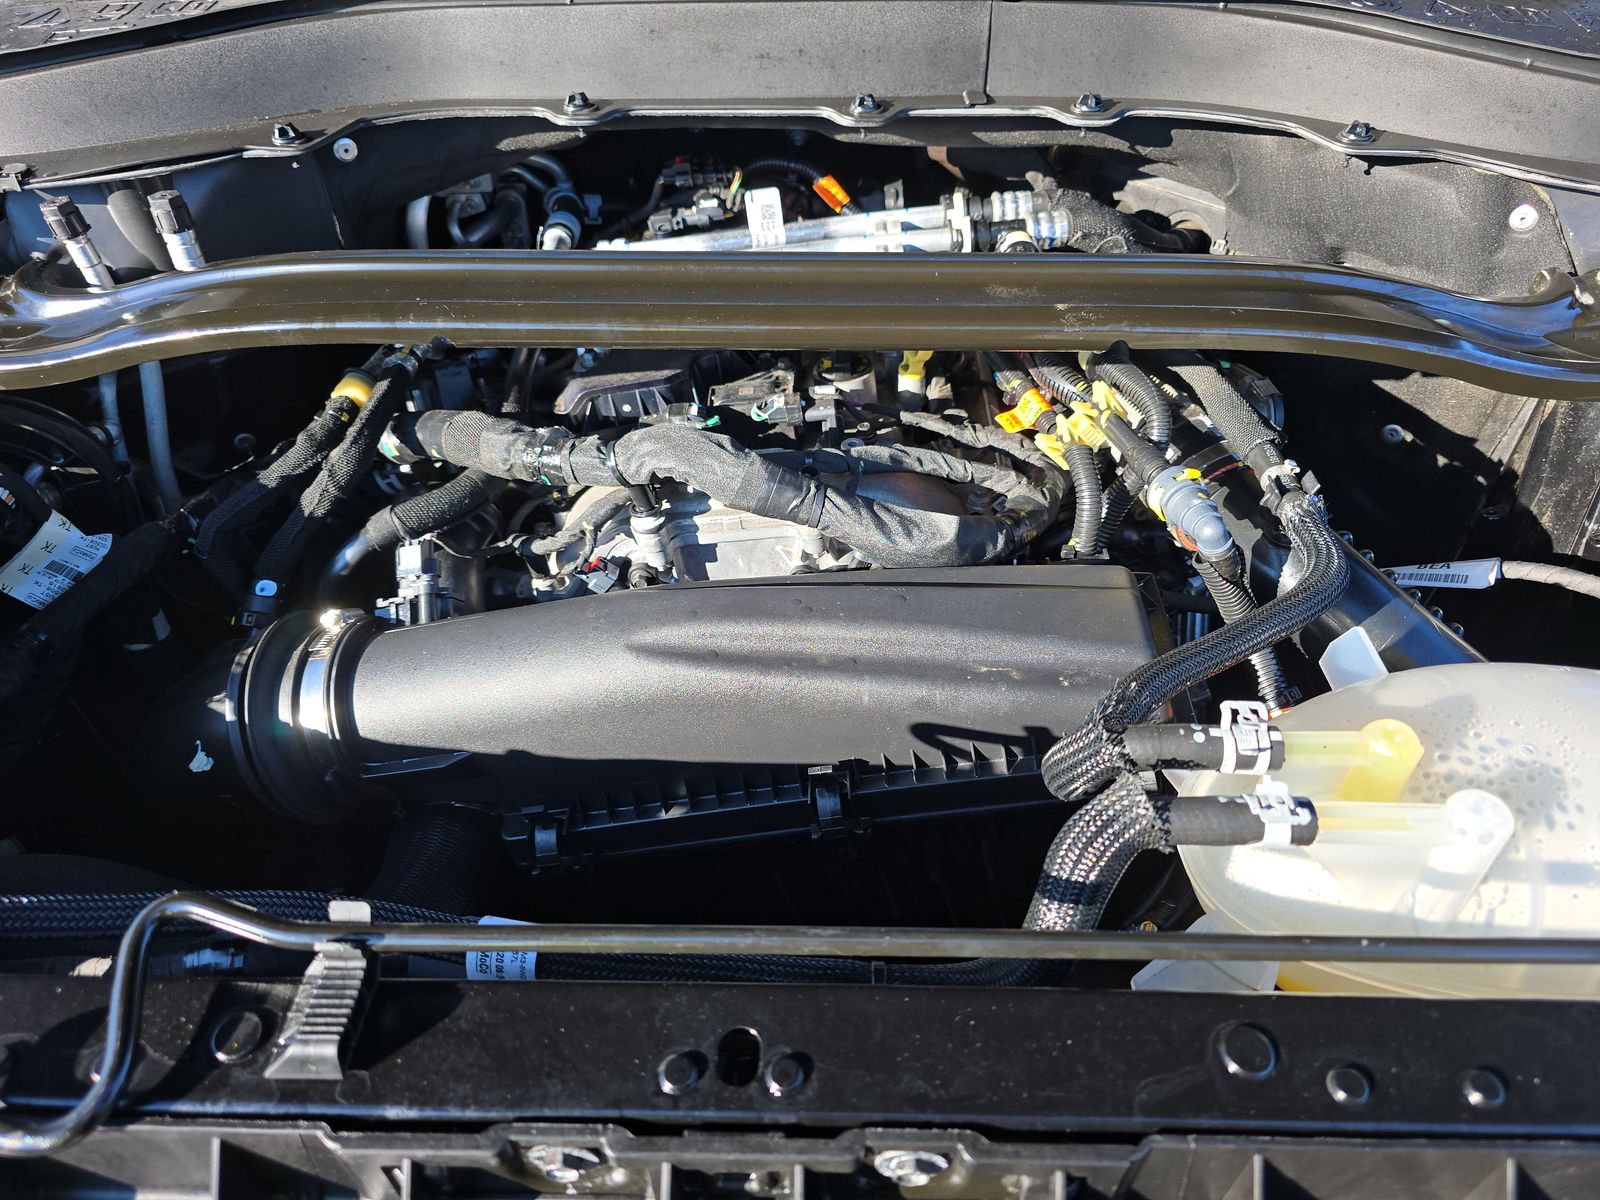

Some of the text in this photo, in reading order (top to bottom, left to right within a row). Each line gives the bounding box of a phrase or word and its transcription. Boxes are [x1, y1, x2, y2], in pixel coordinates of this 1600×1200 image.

[58, 518, 72, 532] TK
[40, 540, 57, 554] TK
[17, 563, 34, 576] TK
